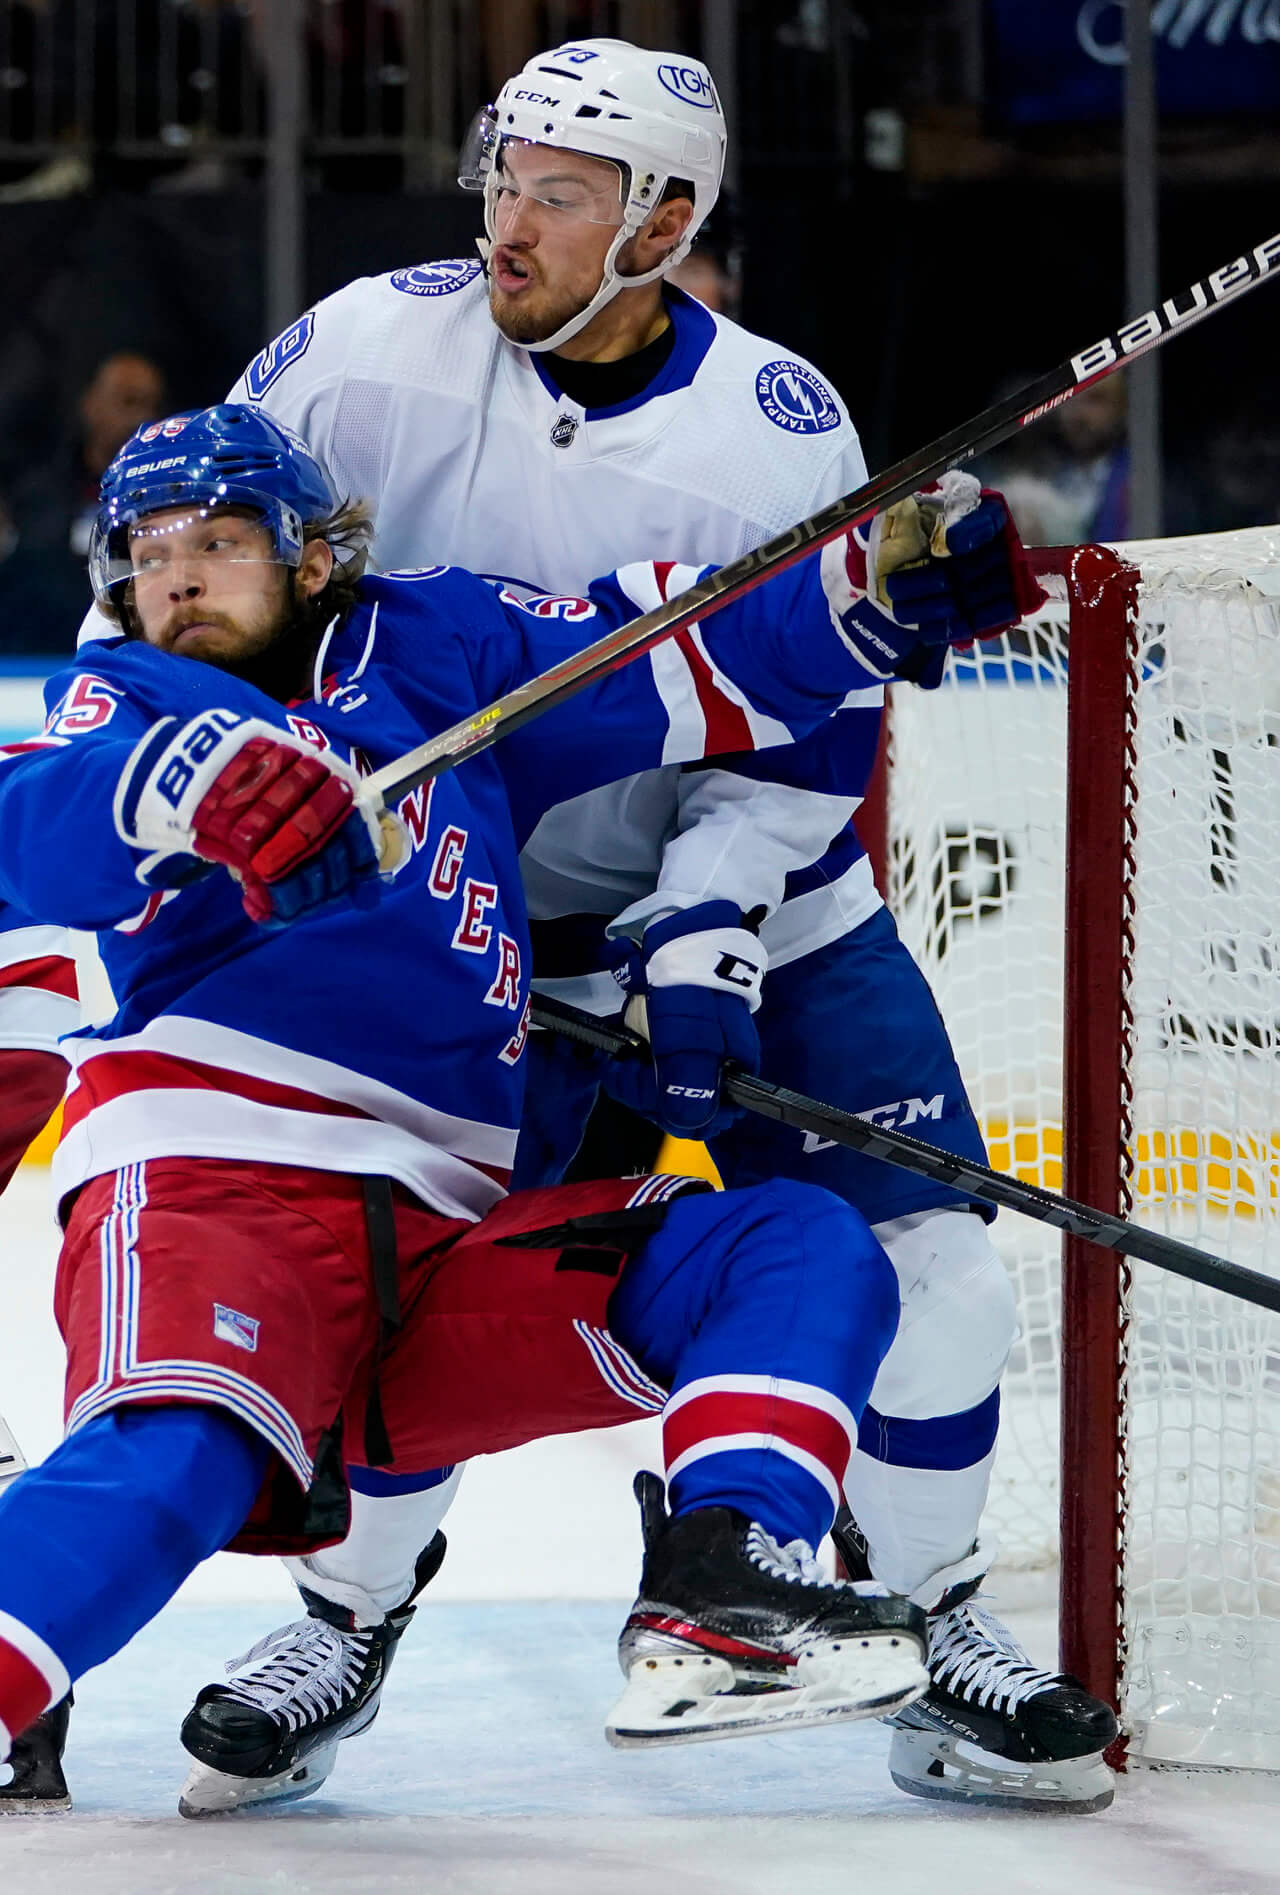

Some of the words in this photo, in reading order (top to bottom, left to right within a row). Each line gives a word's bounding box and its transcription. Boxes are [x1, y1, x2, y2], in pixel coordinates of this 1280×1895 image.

[514, 89, 561, 108] CCM
[662, 64, 714, 102] TGH
[759, 371, 772, 395] BAY
[767, 361, 833, 405] LIGHTNING
[762, 397, 807, 431] TAMPA
[125, 455, 188, 479] BAUER
[850, 618, 900, 660] BAUER
[666, 1084, 716, 1099] CCM
[916, 1698, 980, 1741] BAUER
